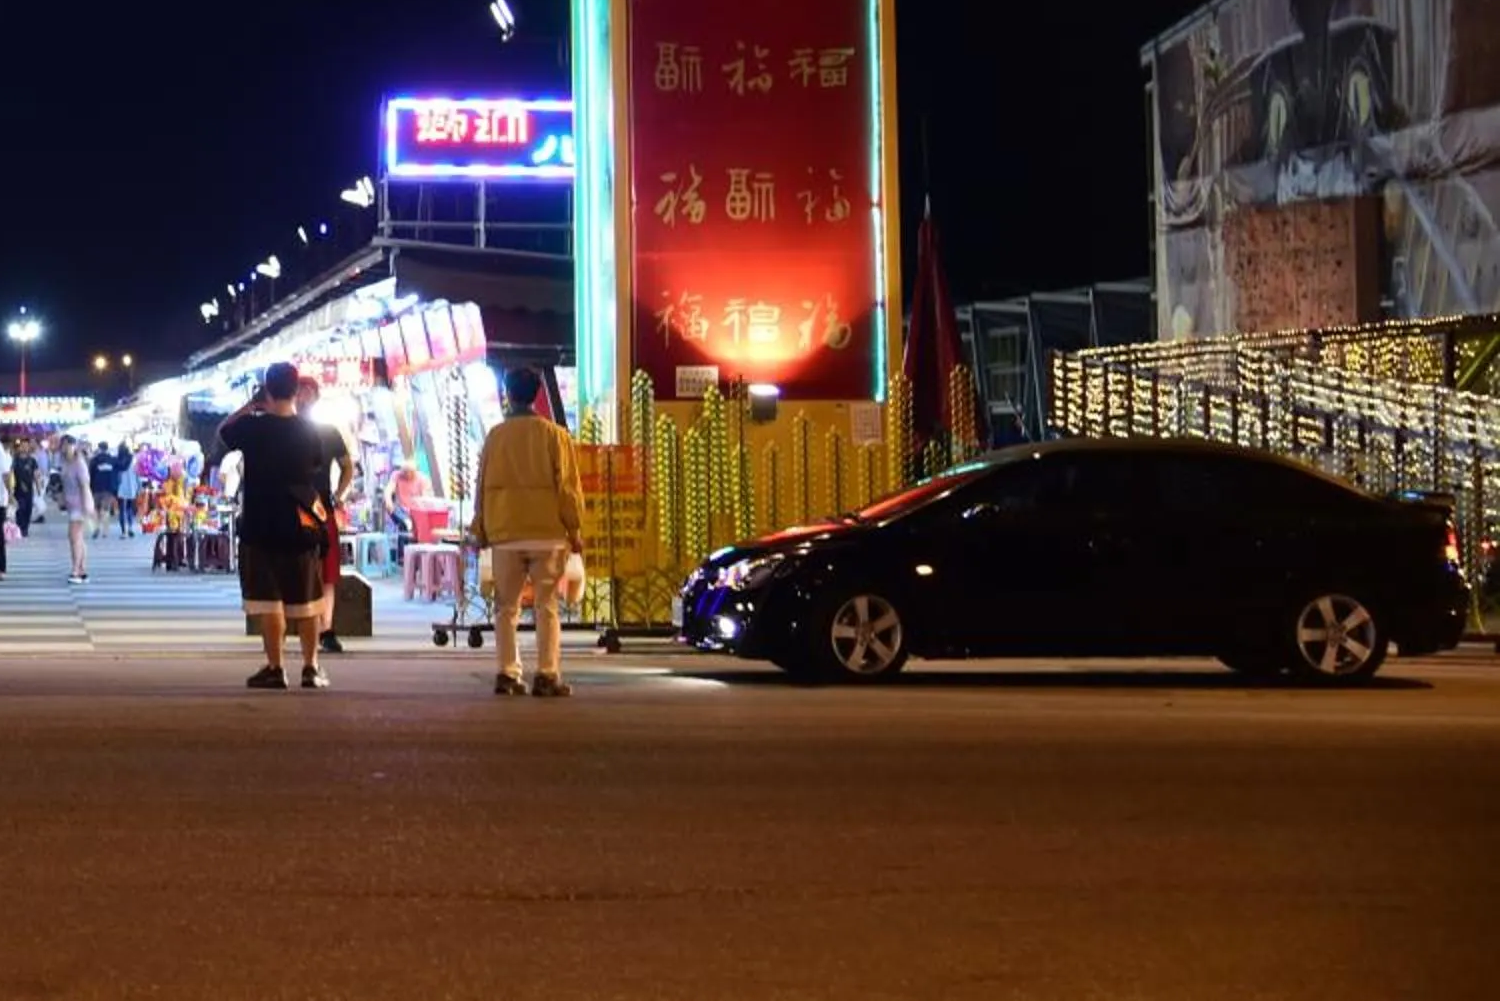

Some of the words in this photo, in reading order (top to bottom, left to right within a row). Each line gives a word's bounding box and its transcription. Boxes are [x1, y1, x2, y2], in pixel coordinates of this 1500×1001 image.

[655, 42, 702, 92] 福
[722, 41, 773, 95] 福
[788, 48, 855, 87] 福
[655, 164, 706, 226] 福
[726, 168, 775, 222] 福
[797, 167, 850, 223] 福
[657, 289, 709, 346] 福
[720, 298, 785, 350] 福
[792, 292, 851, 356] 福
